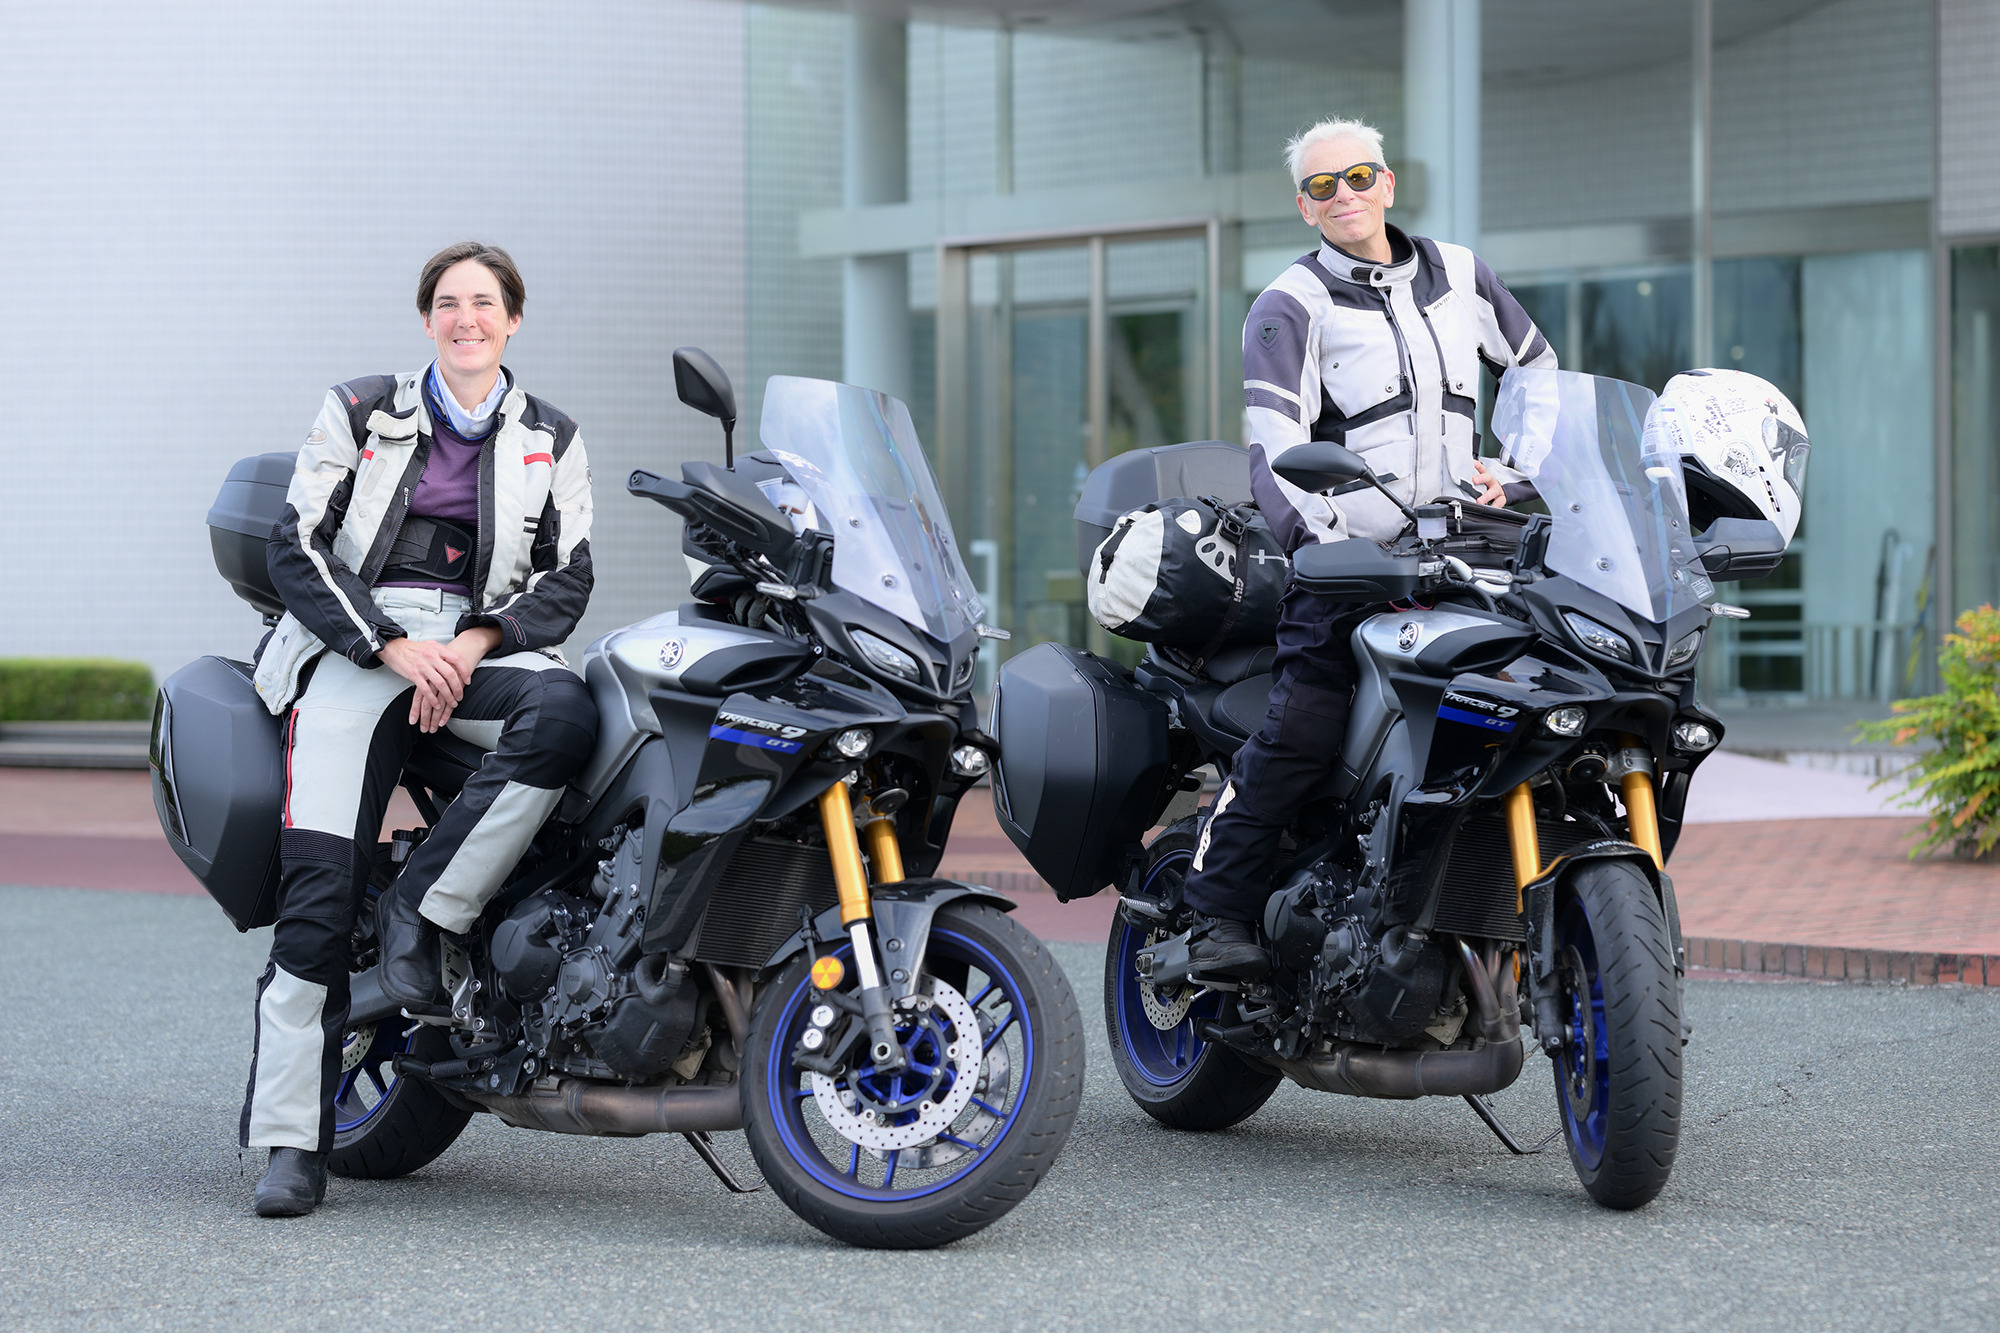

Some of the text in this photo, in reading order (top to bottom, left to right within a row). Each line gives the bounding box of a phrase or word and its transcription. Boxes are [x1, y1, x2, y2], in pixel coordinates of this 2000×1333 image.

[1233, 577, 1244, 603] GIVI
[1444, 691, 1520, 718] TRACER 9
[719, 711, 807, 739] TRACER 9
[1484, 718, 1510, 727] GT
[765, 739, 794, 748] GT
